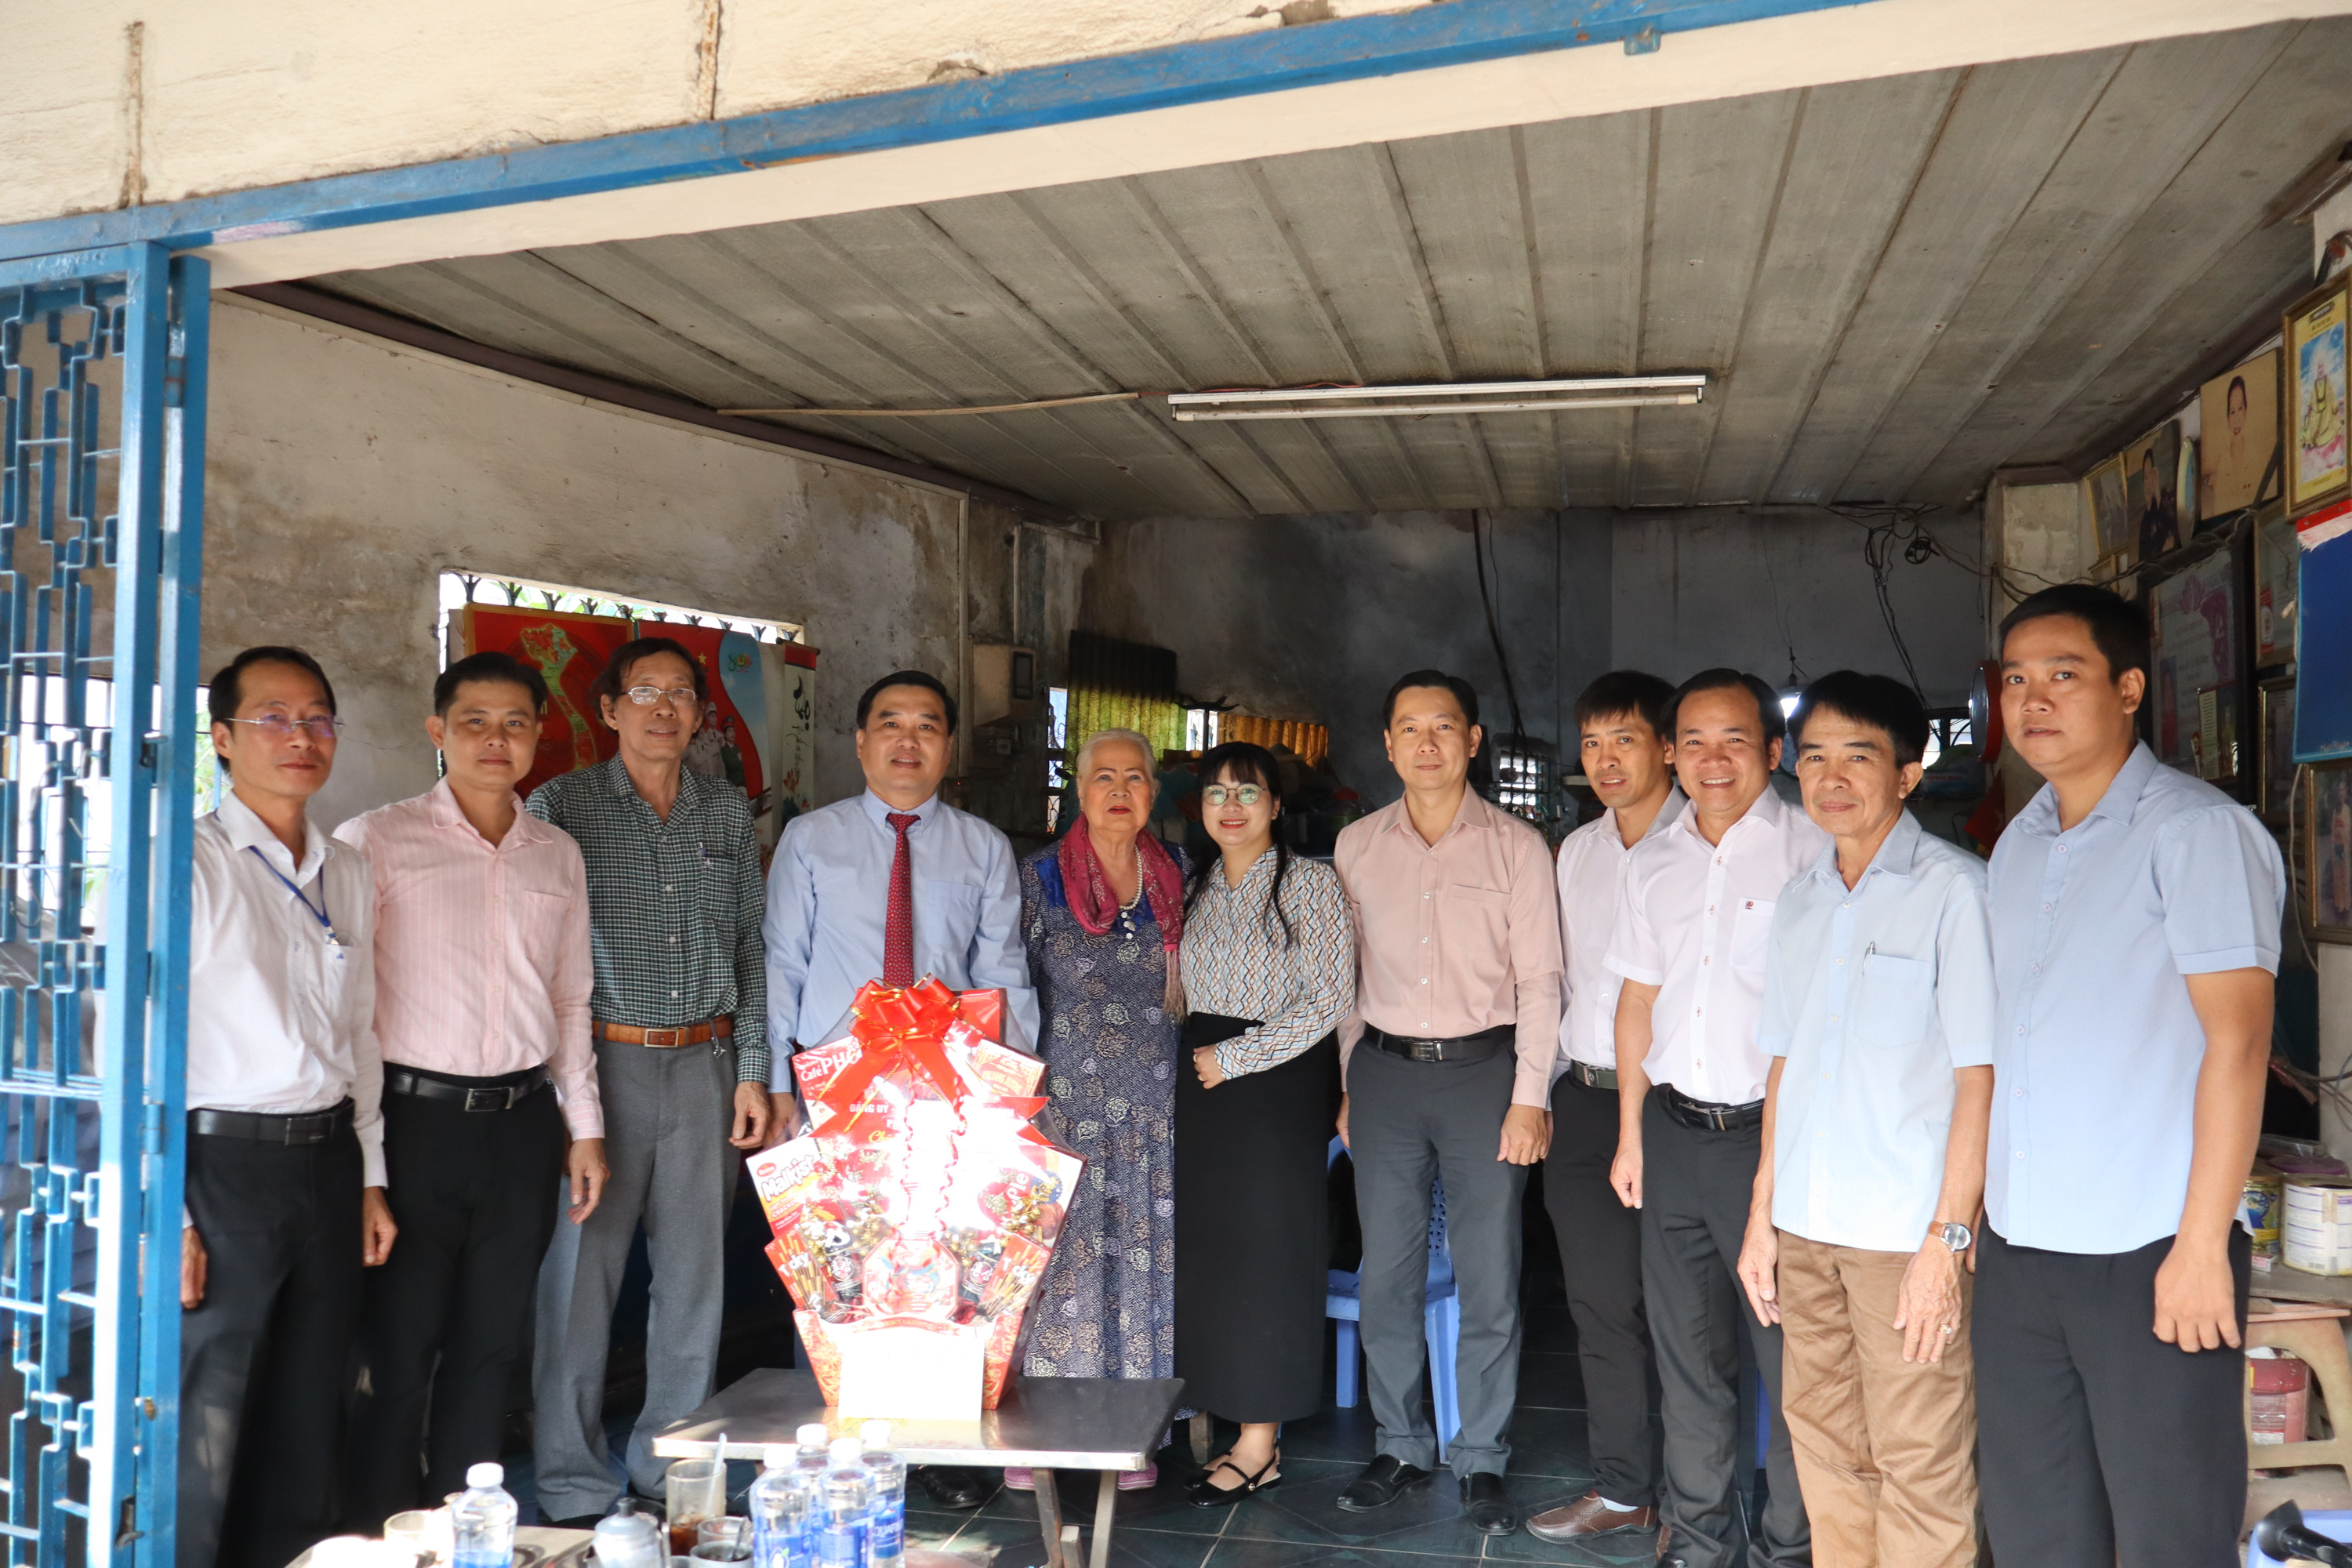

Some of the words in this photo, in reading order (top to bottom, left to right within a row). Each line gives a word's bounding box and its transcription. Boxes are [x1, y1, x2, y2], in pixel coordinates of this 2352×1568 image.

[800, 1065, 823, 1082] Café
[760, 1154, 815, 1203] Malkist
[772, 1199, 798, 1218] CRACKE
[778, 1252, 811, 1278] Tcky
[1003, 1257, 1038, 1286] Tcky
